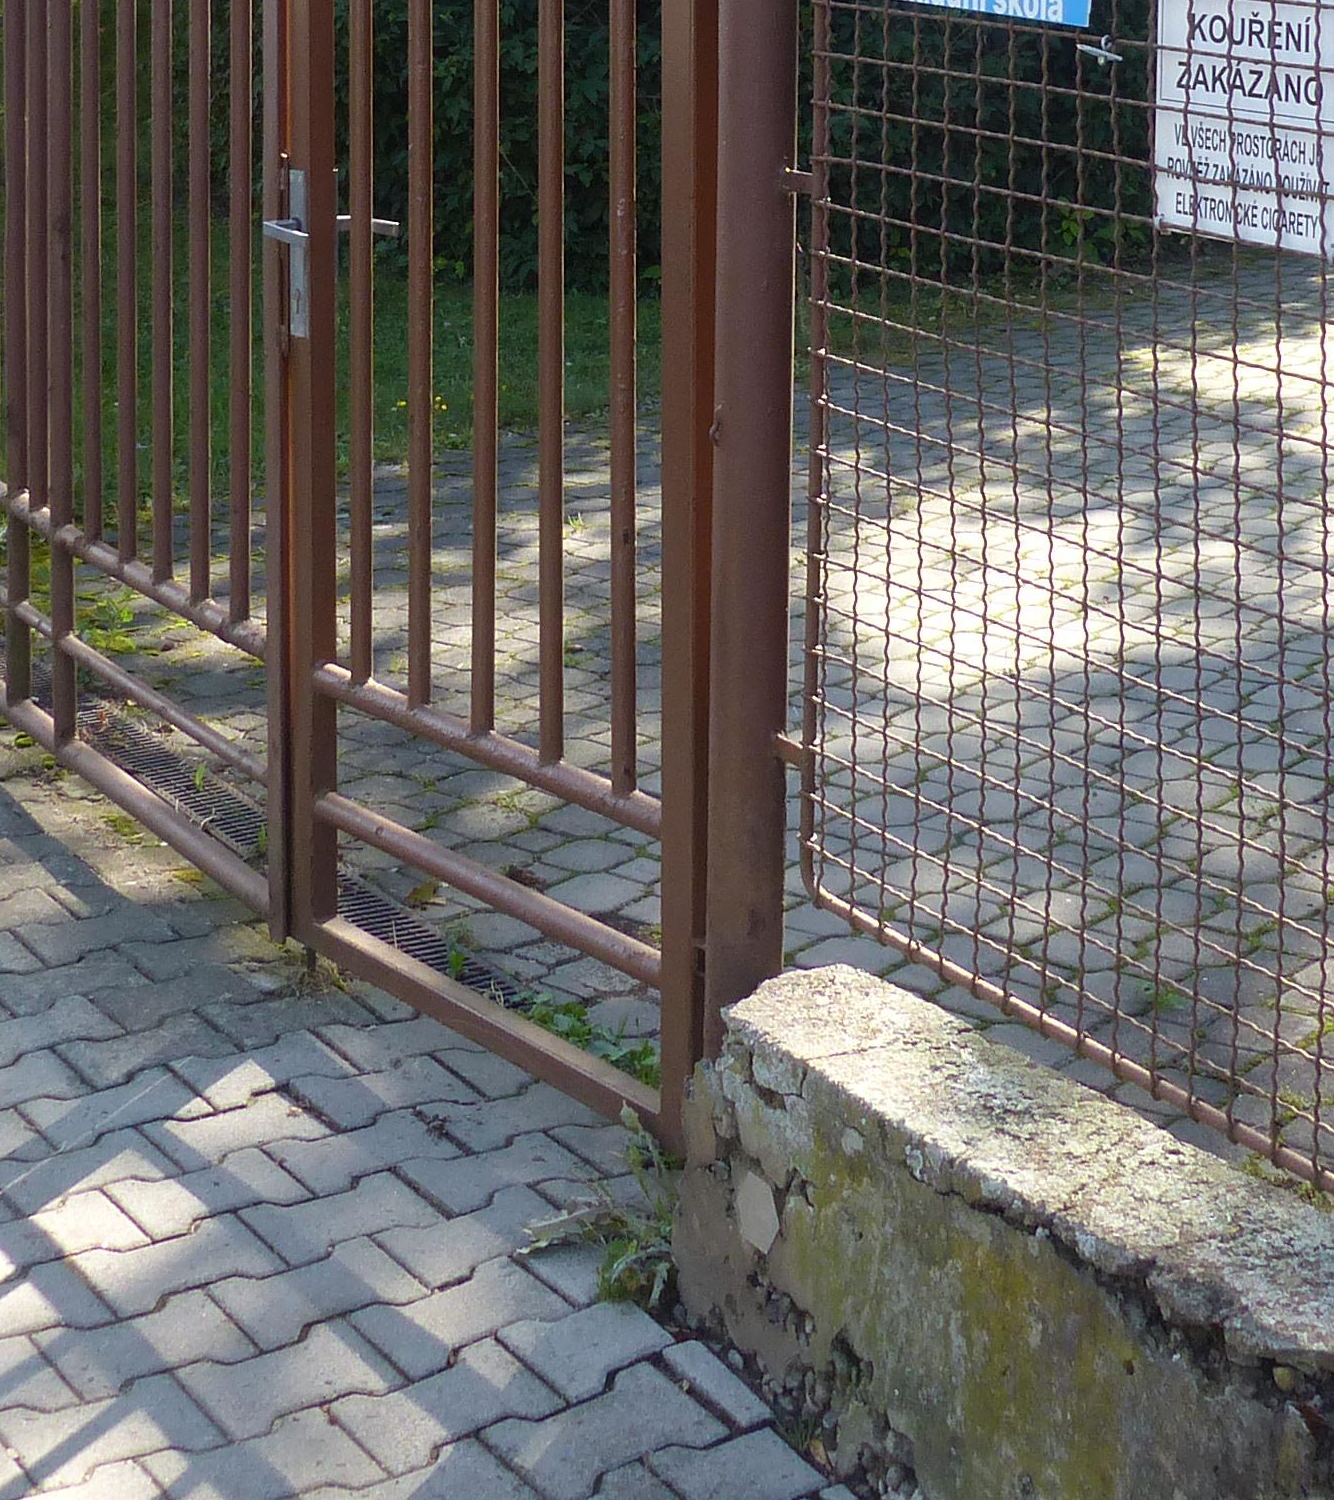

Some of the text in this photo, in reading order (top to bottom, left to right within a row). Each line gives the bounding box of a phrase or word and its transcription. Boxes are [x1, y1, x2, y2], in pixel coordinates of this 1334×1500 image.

[1192, 11, 1312, 53] KOUŘENÍ
[1190, 121, 1227, 152] VŠECH
[1175, 192, 1258, 228] ELEKTRONCKÉ
